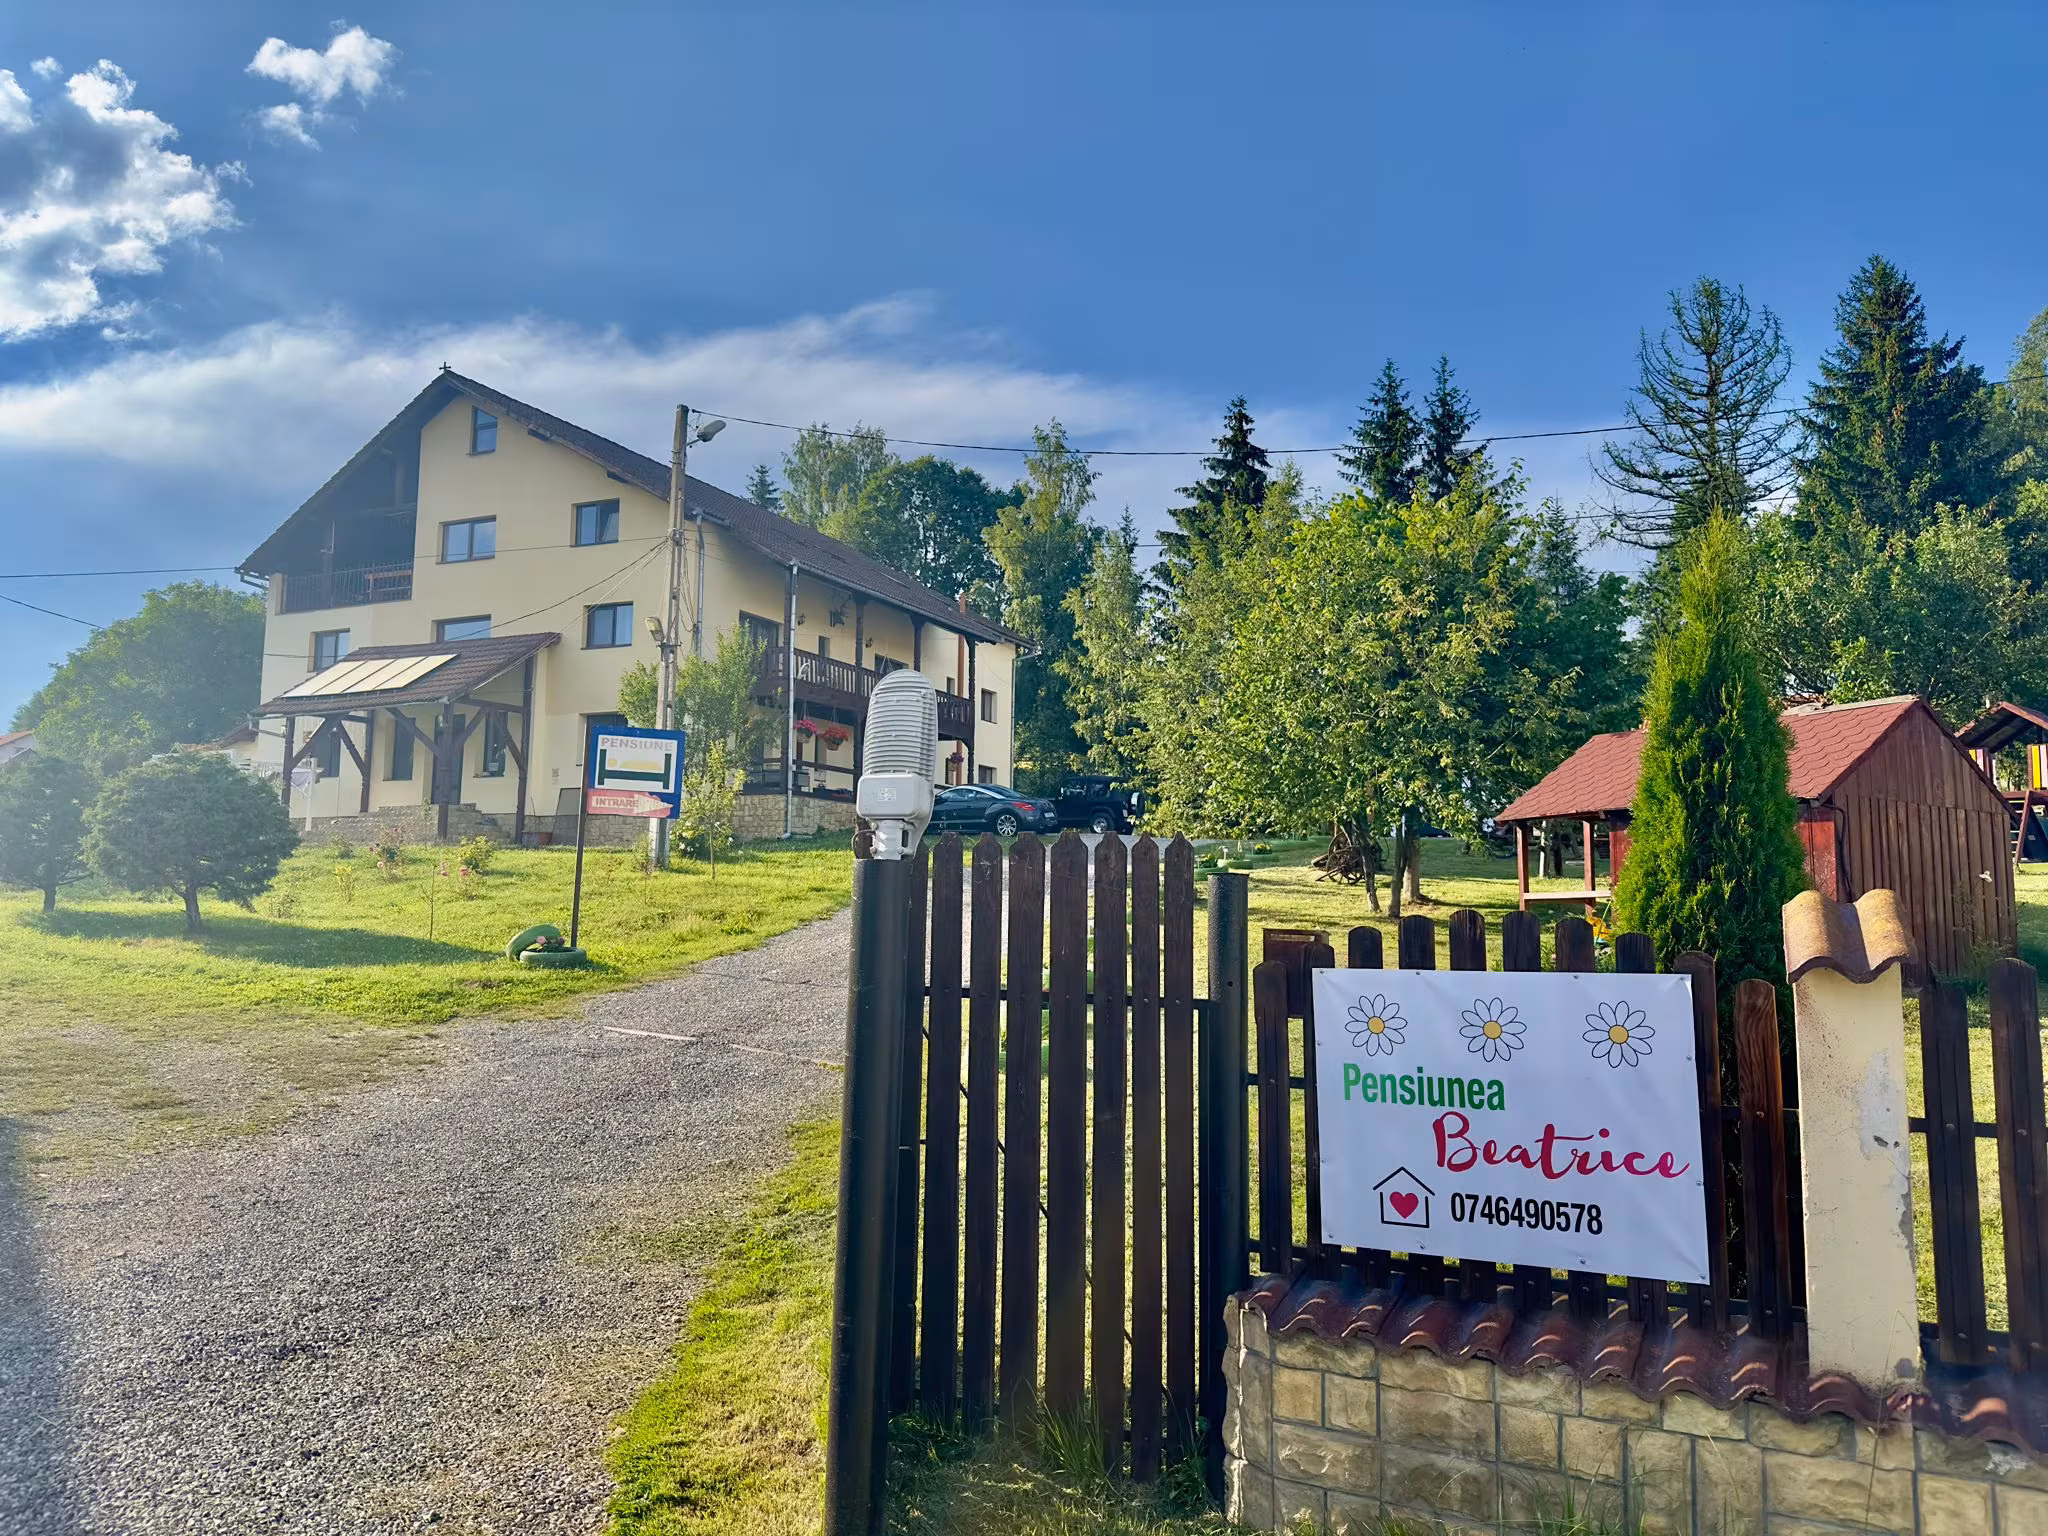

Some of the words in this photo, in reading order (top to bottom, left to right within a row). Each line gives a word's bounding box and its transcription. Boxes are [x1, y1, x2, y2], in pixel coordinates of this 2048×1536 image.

[600, 737, 673, 751] PENSIUNE
[595, 797, 639, 808] INTRARE
[1343, 1062, 1505, 1111] Pensiunea
[1432, 1111, 1690, 1179] Beatrice
[1450, 1192, 1603, 1235] 0746490578
